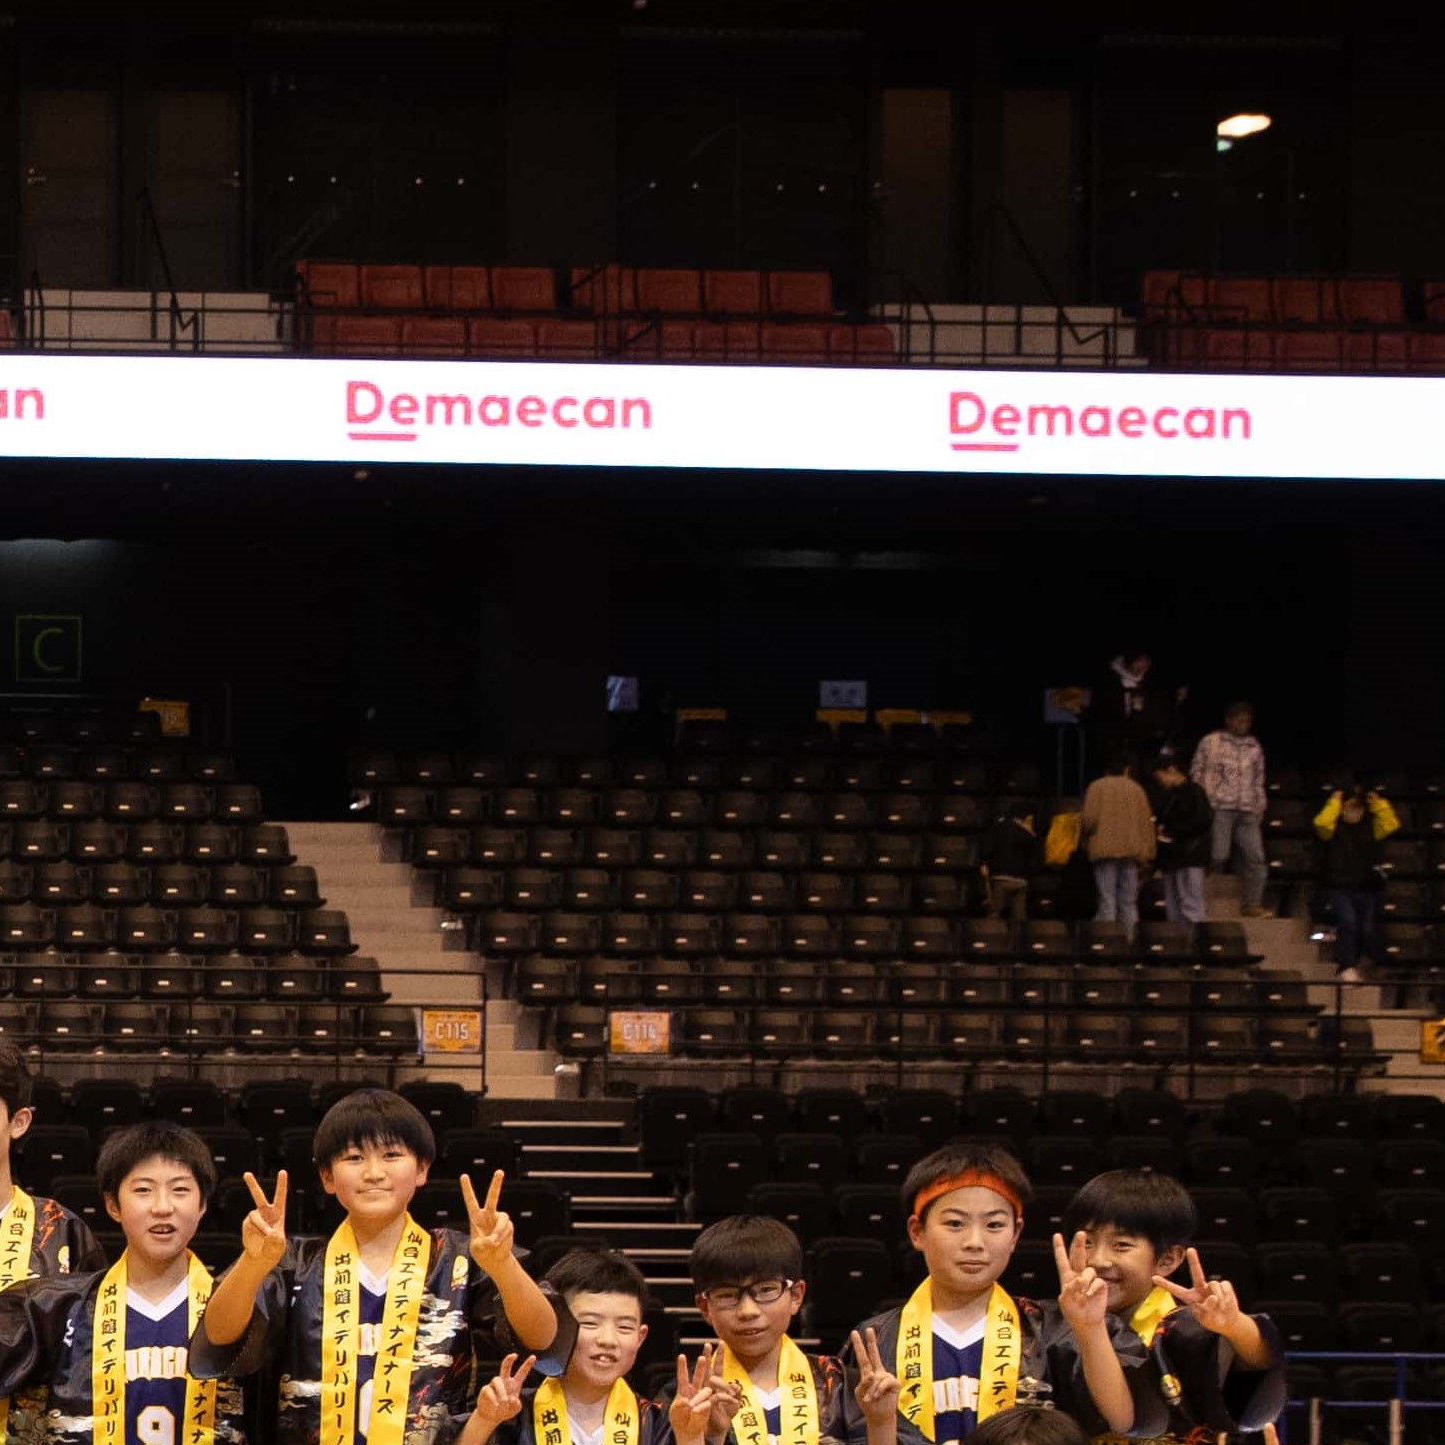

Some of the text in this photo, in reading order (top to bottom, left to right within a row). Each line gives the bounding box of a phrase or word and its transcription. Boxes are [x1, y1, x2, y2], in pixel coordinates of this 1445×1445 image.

[347, 381, 651, 428] Demaecan
[950, 392, 1250, 438] Demaecan
[377, 1231, 422, 1414] 仙台エイティナイナーズ
